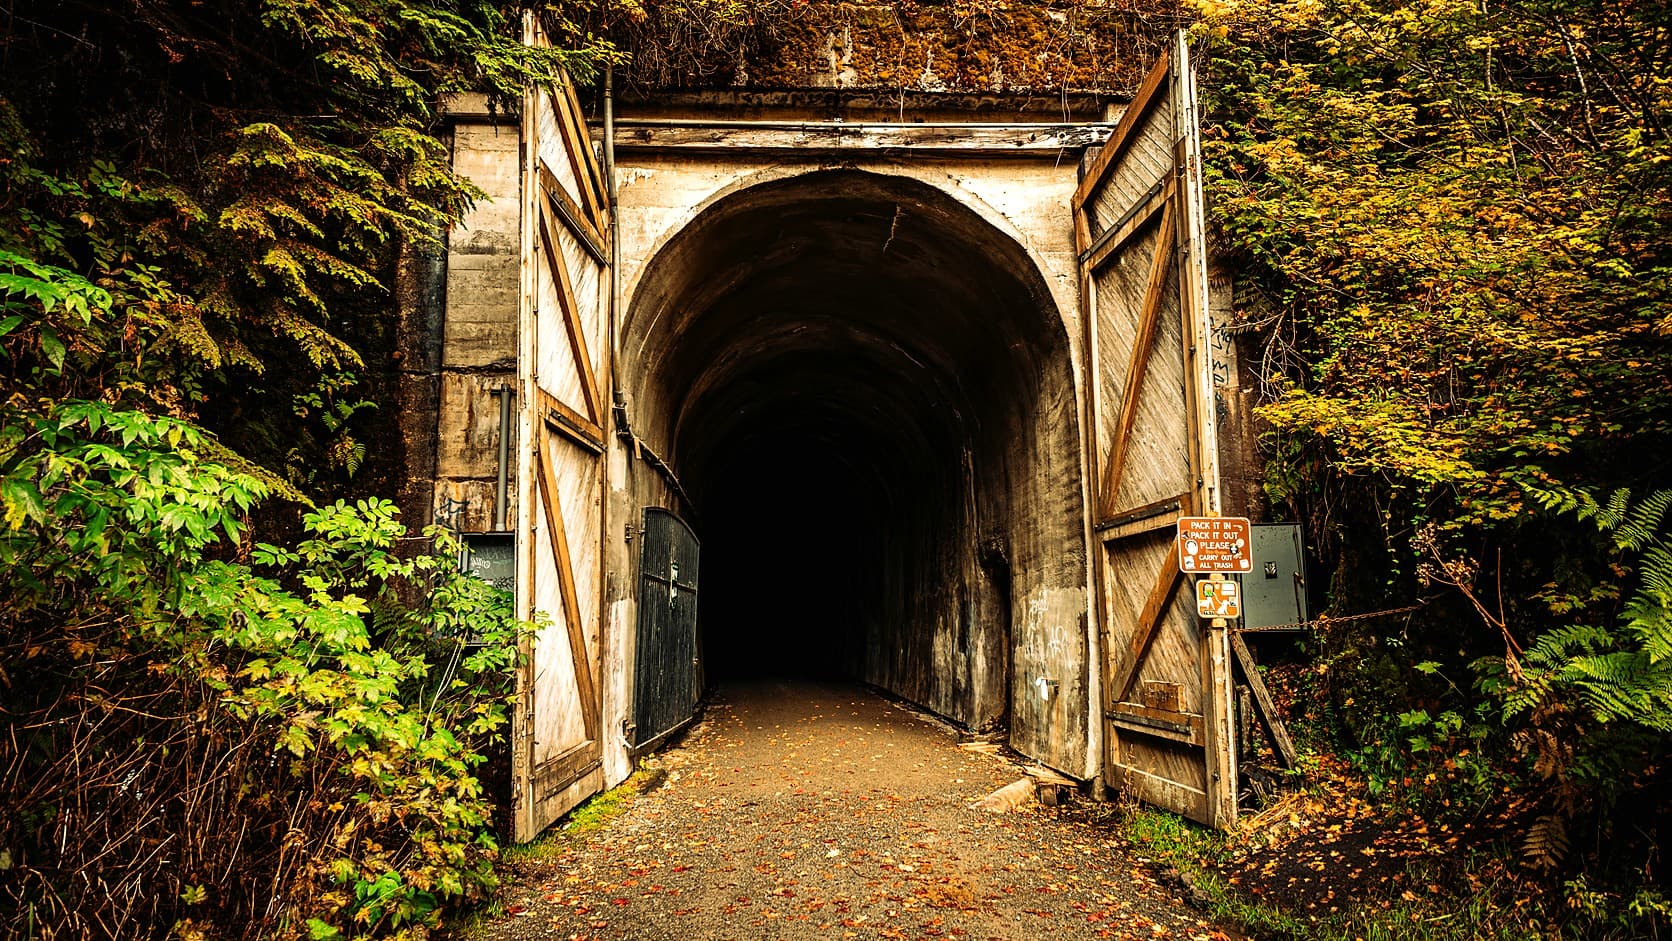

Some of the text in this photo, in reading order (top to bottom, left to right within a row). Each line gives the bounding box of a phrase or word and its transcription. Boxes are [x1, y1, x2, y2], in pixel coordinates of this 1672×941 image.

[1190, 521, 1231, 530] PACK IT IN
[1190, 531, 1238, 540] PACK IT OUT
[1200, 541, 1230, 550] PLEASE
